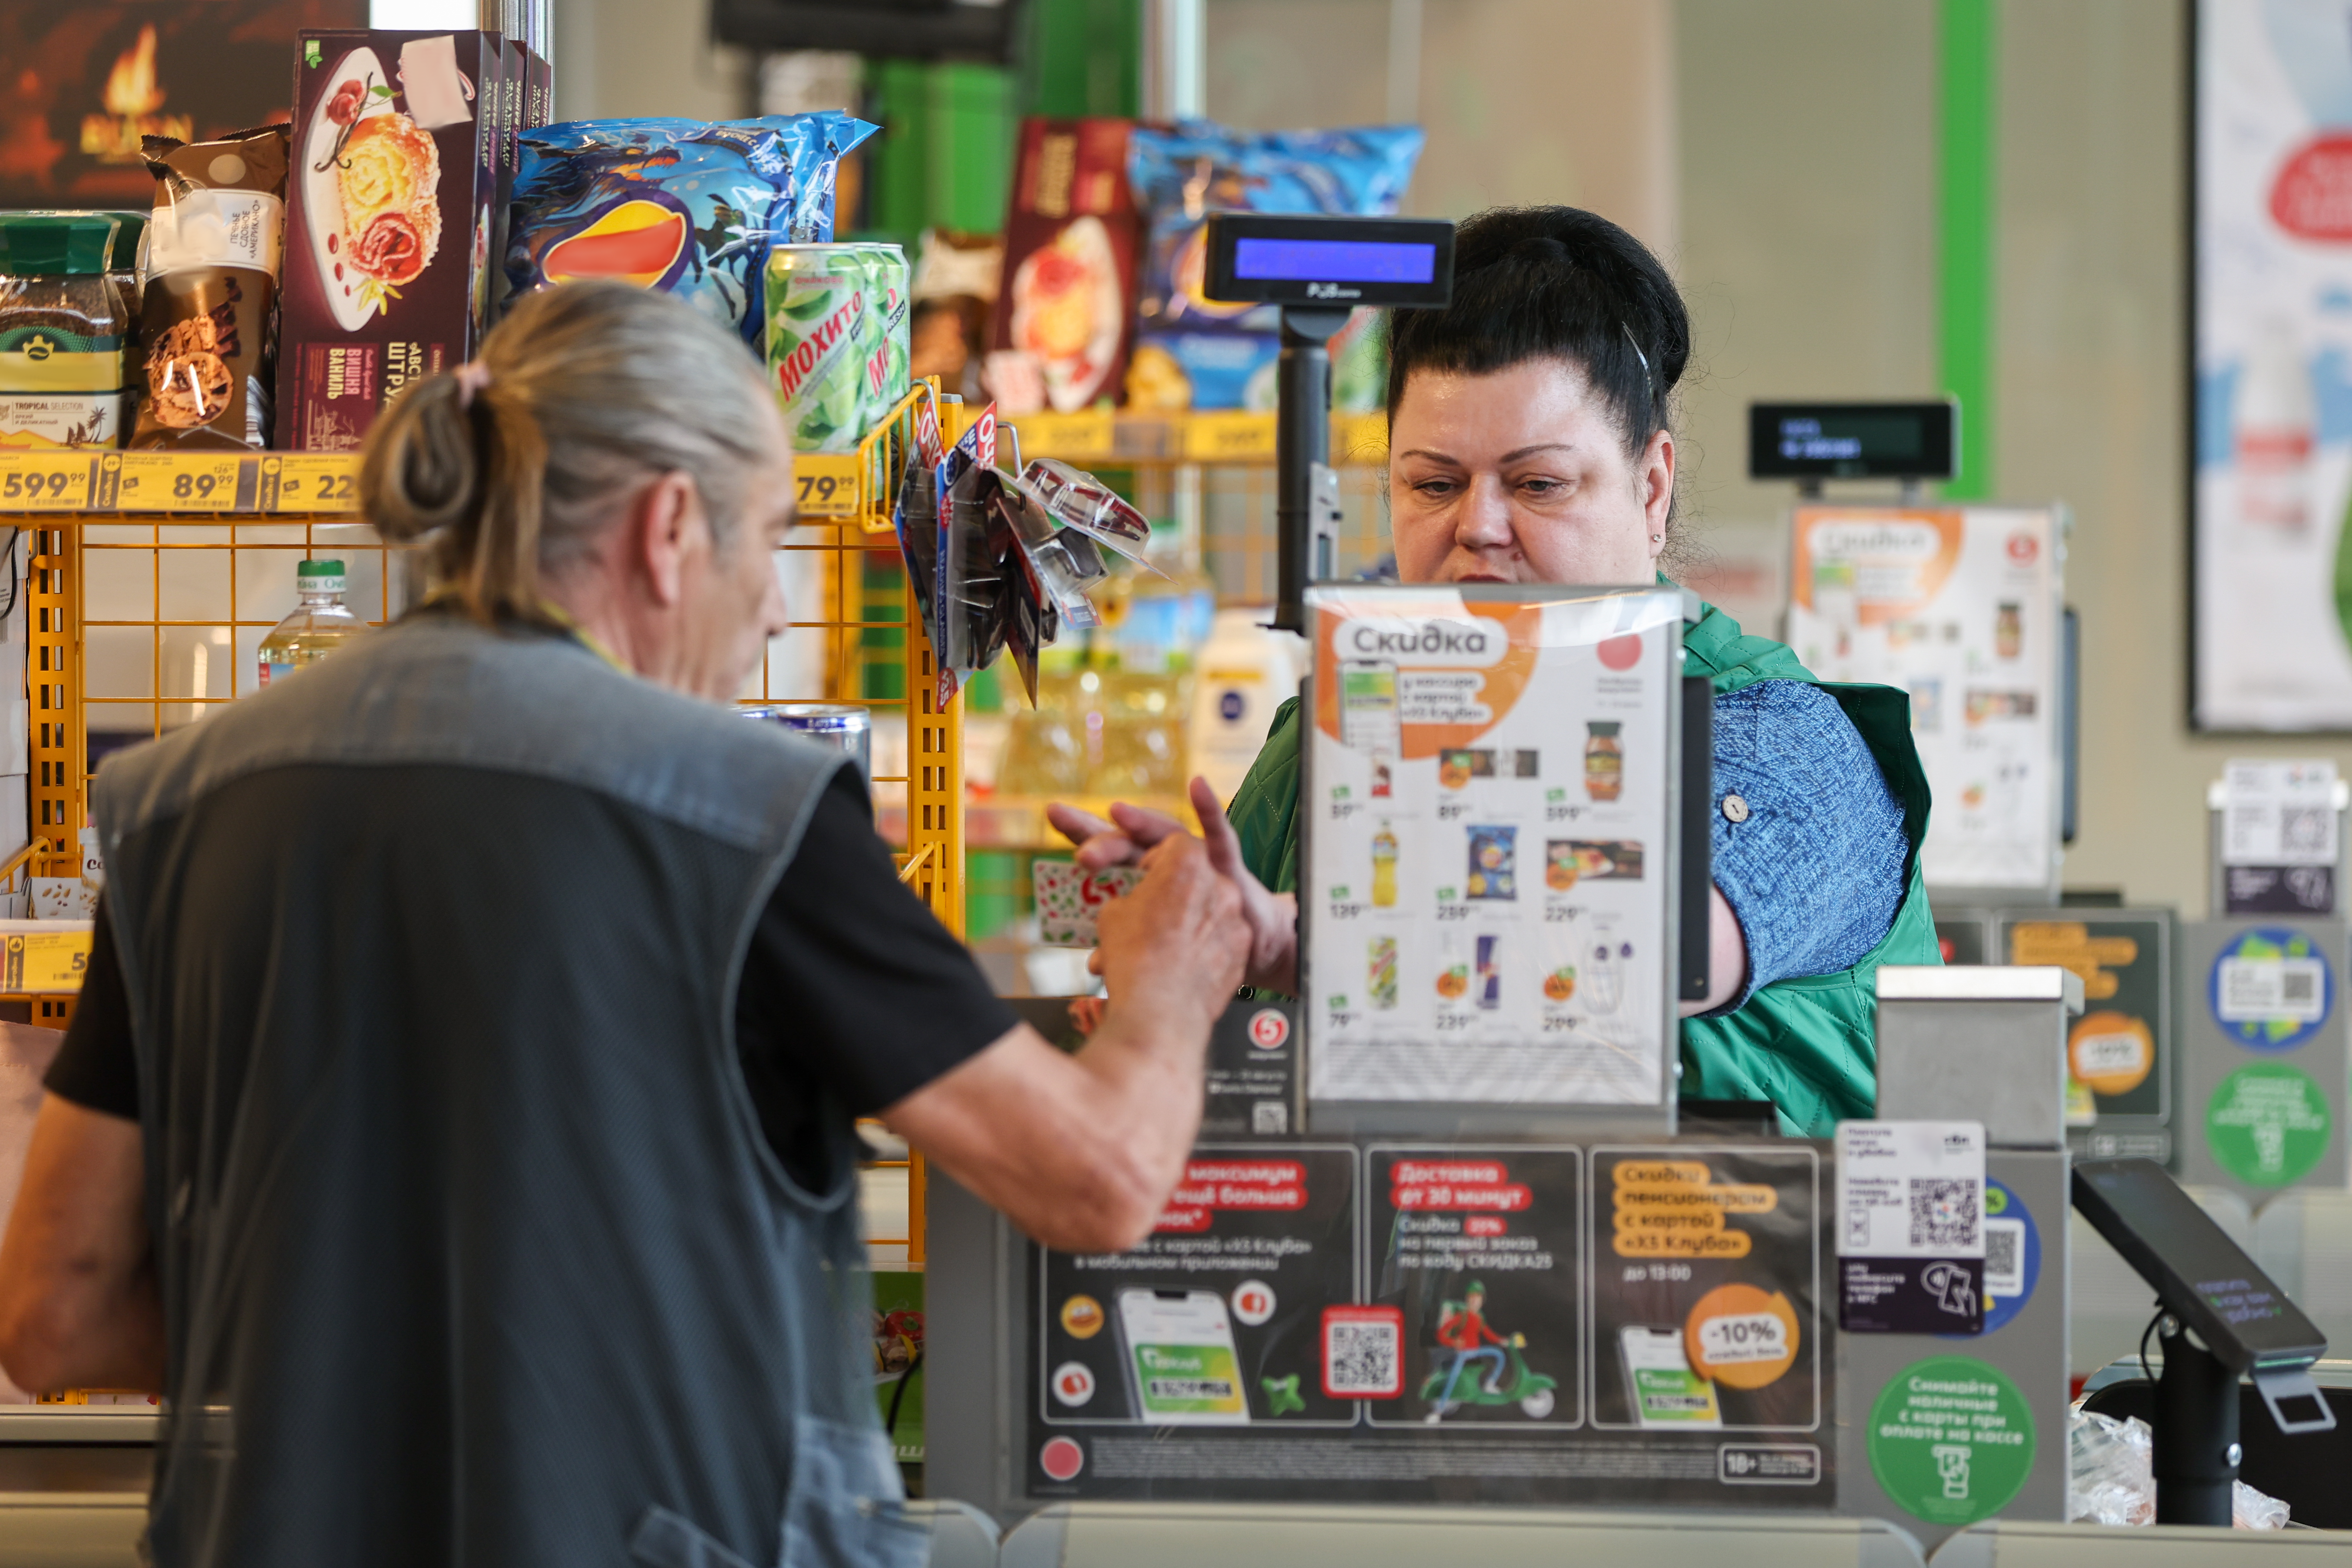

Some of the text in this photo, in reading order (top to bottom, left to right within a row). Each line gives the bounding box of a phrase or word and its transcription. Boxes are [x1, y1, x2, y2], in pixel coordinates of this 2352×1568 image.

[231, 213, 240, 244] ПЕЧЕНЬЕ
[240, 211, 250, 248] СДОБНОЕ
[249, 200, 260, 259] «АМЕРИКАНО»
[889, 301, 905, 333] RESH
[779, 290, 862, 403] МОХИТО
[327, 348, 346, 400] ВАНИЛЬ
[345, 348, 363, 395] ВИШНЯ
[385, 342, 406, 404] ШТРУ
[3, 472, 86, 498] 599 99
[173, 474, 234, 498] 89 99
[798, 477, 836, 501] 79
[1353, 624, 1486, 653] Скидка
[1397, 1165, 1499, 1184] Доставка
[1623, 1166, 1701, 1184] Скидки
[1219, 1185, 1298, 1206] больше
[1455, 1189, 1524, 1209] минут
[1398, 1217, 1460, 1233] Скидка
[1640, 1213, 1715, 1230] картой
[1665, 1234, 1741, 1254] Клуба»
[1087, 1255, 1178, 1271] мобильном
[1710, 1319, 1777, 1344] -10%
[1908, 1375, 1999, 1396] Снимайте
[1907, 1395, 1999, 1412] наличные
[1898, 1410, 2007, 1429] с карты при
[1880, 1423, 2024, 1446] оплате на кассе
[1726, 1452, 1757, 1475] 18+
